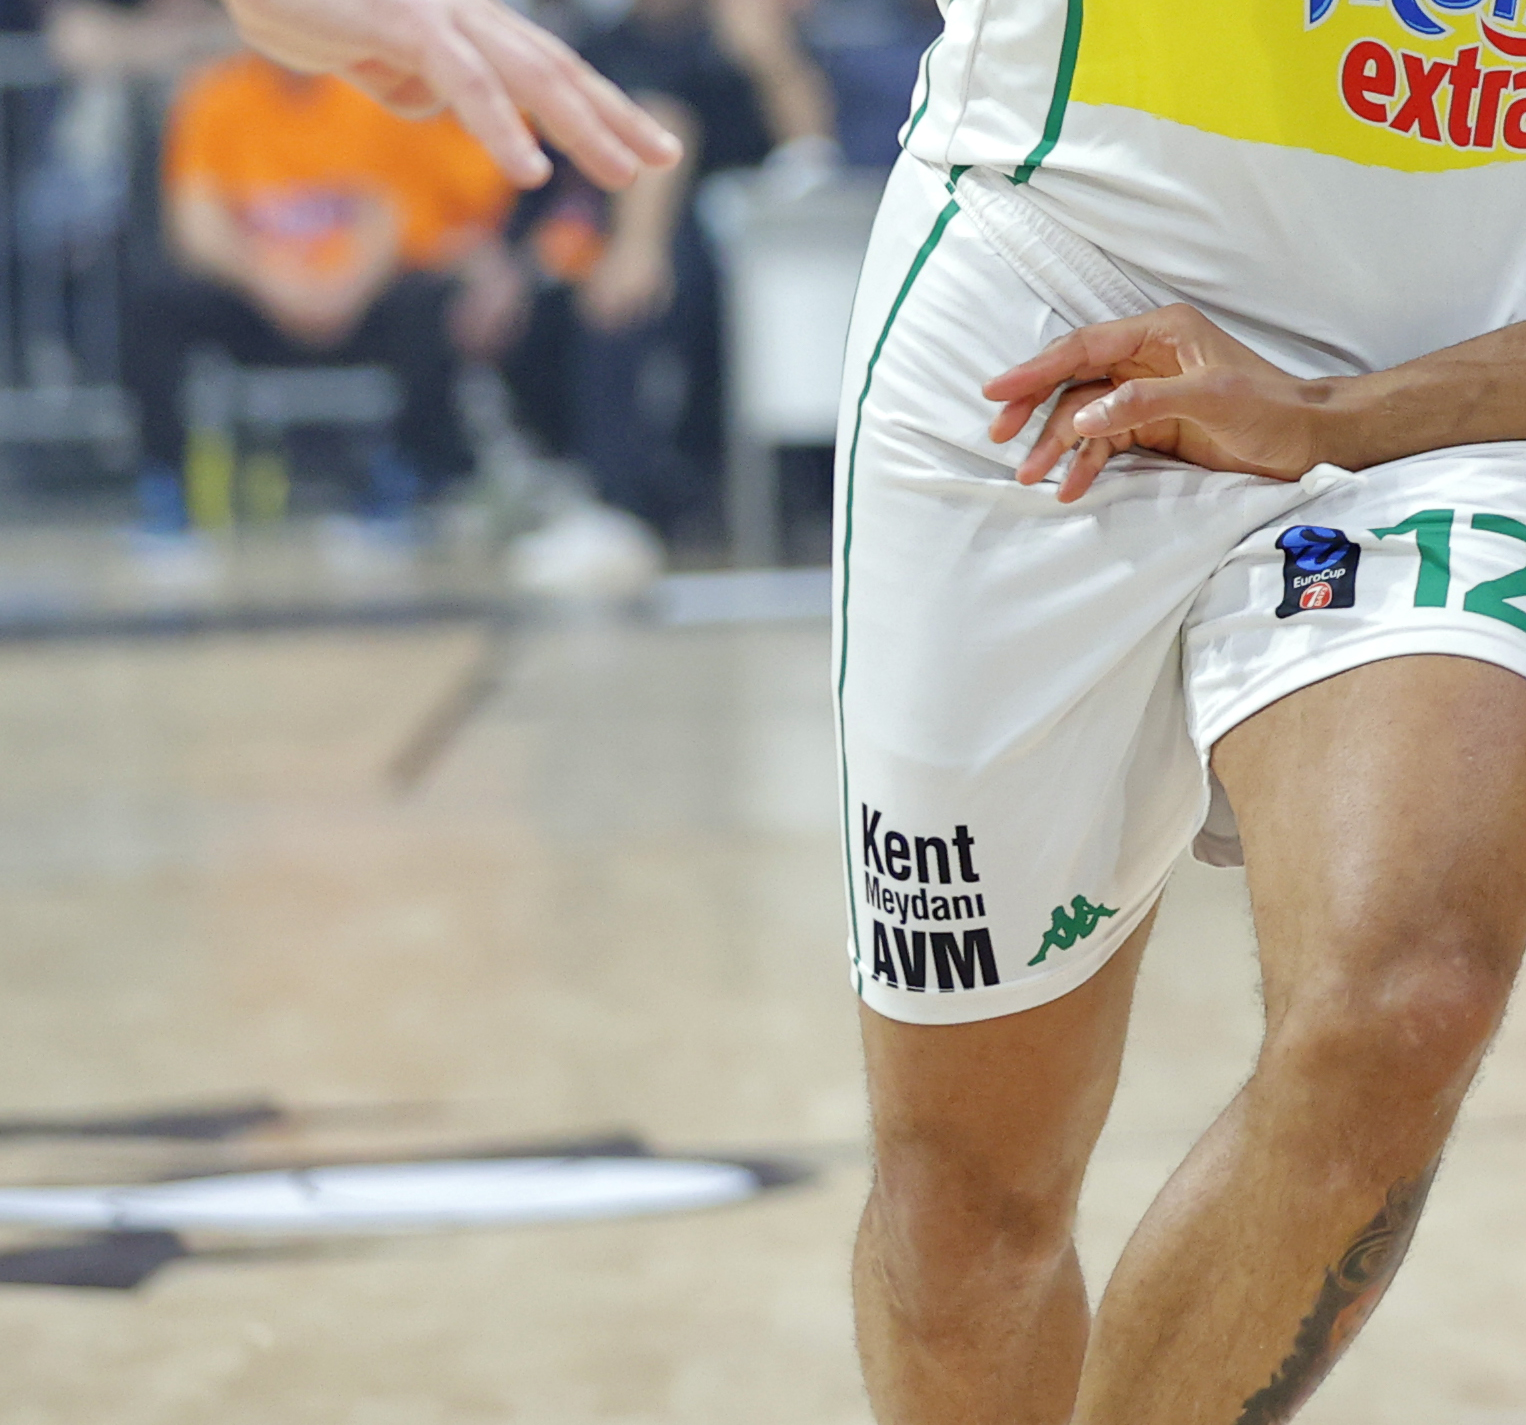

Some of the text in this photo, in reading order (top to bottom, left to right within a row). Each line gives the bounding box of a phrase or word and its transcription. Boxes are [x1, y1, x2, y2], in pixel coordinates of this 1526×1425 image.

[1293, 568, 1346, 589] EuroCup
[862, 802, 980, 884] Kent
[864, 871, 986, 924] Meydanı
[871, 918, 1000, 993] AVM
